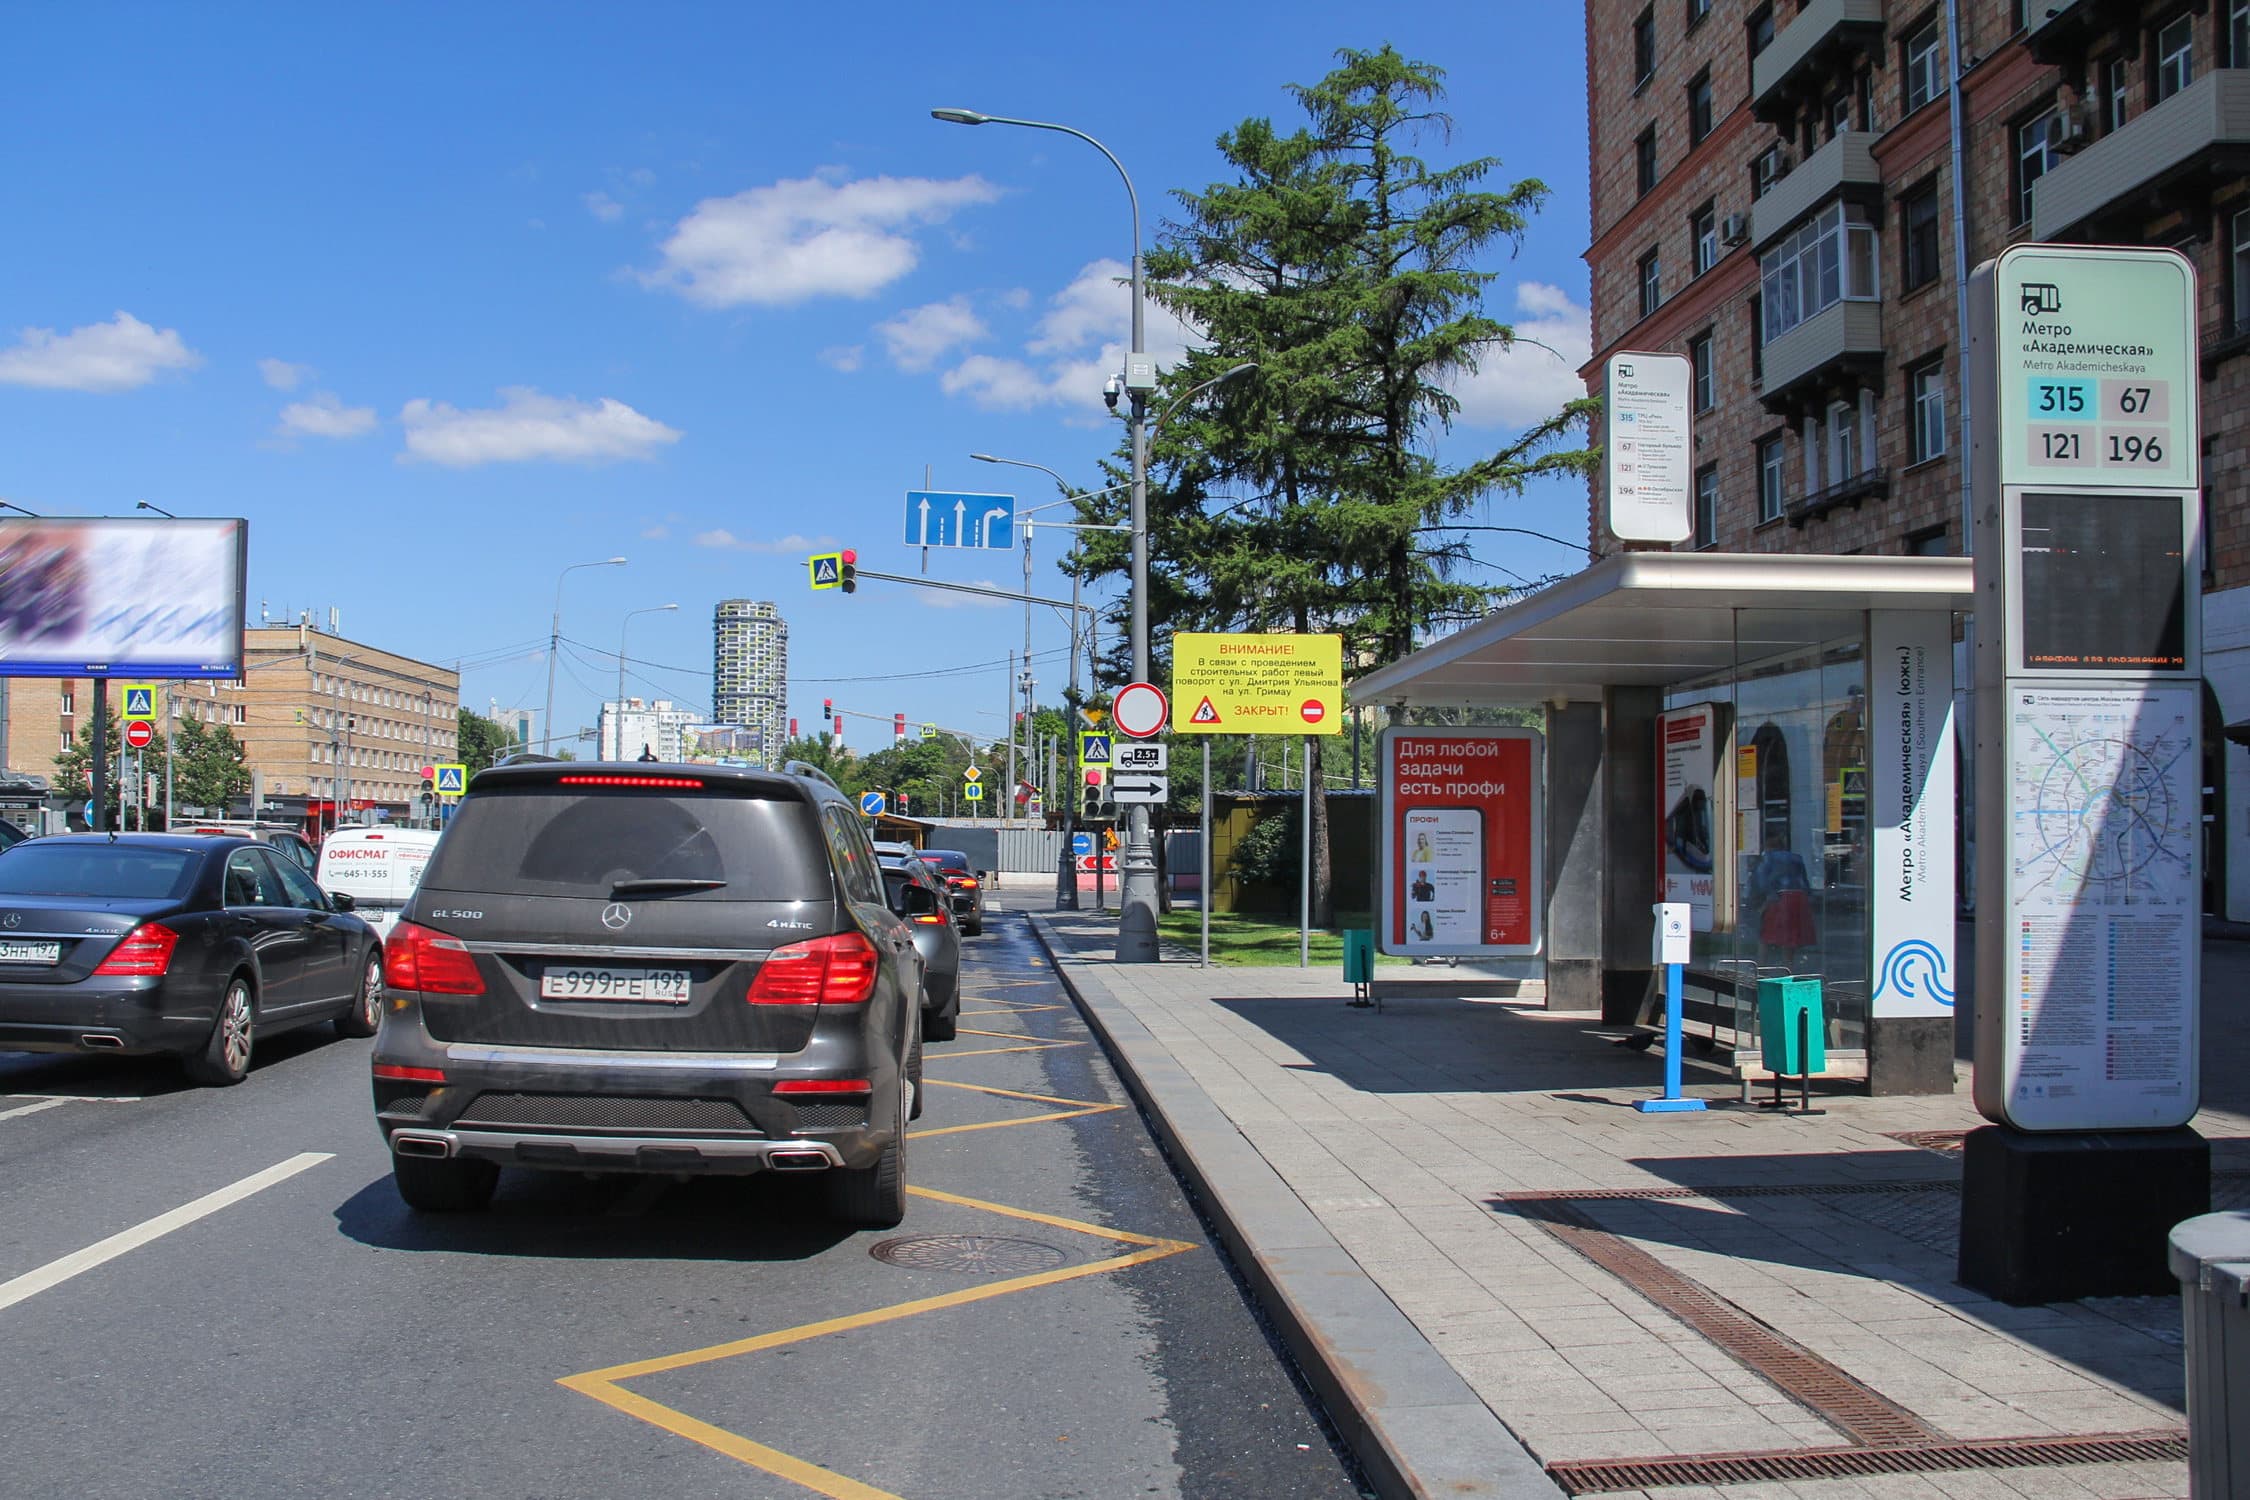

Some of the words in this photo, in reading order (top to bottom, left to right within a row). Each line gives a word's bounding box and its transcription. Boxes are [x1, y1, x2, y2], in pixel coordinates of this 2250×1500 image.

[2022, 321, 2072, 338] Метро
[2022, 339, 2154, 356] «Академическая»
[2022, 360, 2053, 370] Metro
[2056, 360, 2146, 374] Akademicheskaya
[2039, 385, 2084, 412] 315
[2120, 387, 2151, 413] 67
[1620, 413, 1633, 421] 315
[1622, 442, 1631, 450] 67
[2042, 433, 2079, 459] 121
[2109, 435, 2162, 462] 196
[1621, 463, 1631, 471] 121
[1220, 644, 1294, 655] ВНИМАНИЕ!
[1198, 658, 1205, 666] В
[1251, 659, 1316, 667] проведением
[1190, 668, 1258, 676] строительных
[1261, 668, 1290, 678] работ
[1294, 668, 1324, 677] левый
[1896, 646, 1911, 696] (южн.)
[1915, 646, 1926, 695] Entrance)
[1175, 678, 1215, 687] поворот
[1229, 679, 1242, 687] ул.
[1247, 678, 1290, 687] Дмитрия
[1294, 678, 1338, 687] Ульянова
[1238, 688, 1251, 697] ул.
[1256, 687, 1292, 697] Гримау
[1234, 705, 1289, 716] ЗАКРЫТ!
[1915, 698, 1927, 750] (Southern
[1136, 750, 1156, 759] 2,5т
[1400, 741, 1435, 757] Для
[1440, 740, 1499, 757] любой
[1400, 762, 1463, 776] задачи
[1900, 702, 1914, 842] «Академическая»
[1400, 782, 1441, 795] есть
[1446, 780, 1505, 798] профи
[1916, 752, 1928, 847] Akademicheskaya
[1409, 815, 1439, 824] ПРОФИ
[328, 849, 389, 859] ОФИСМАГ
[1917, 849, 1926, 883] Metro
[344, 869, 388, 878] 645-1-555
[1900, 848, 1914, 901] Метро
[432, 909, 448, 918] GL
[451, 910, 483, 919] 500
[1490, 928, 1506, 940] 6+
[33, 942, 56, 954] 197
[550, 970, 642, 995] Е999РЕ
[650, 972, 684, 990] 199
